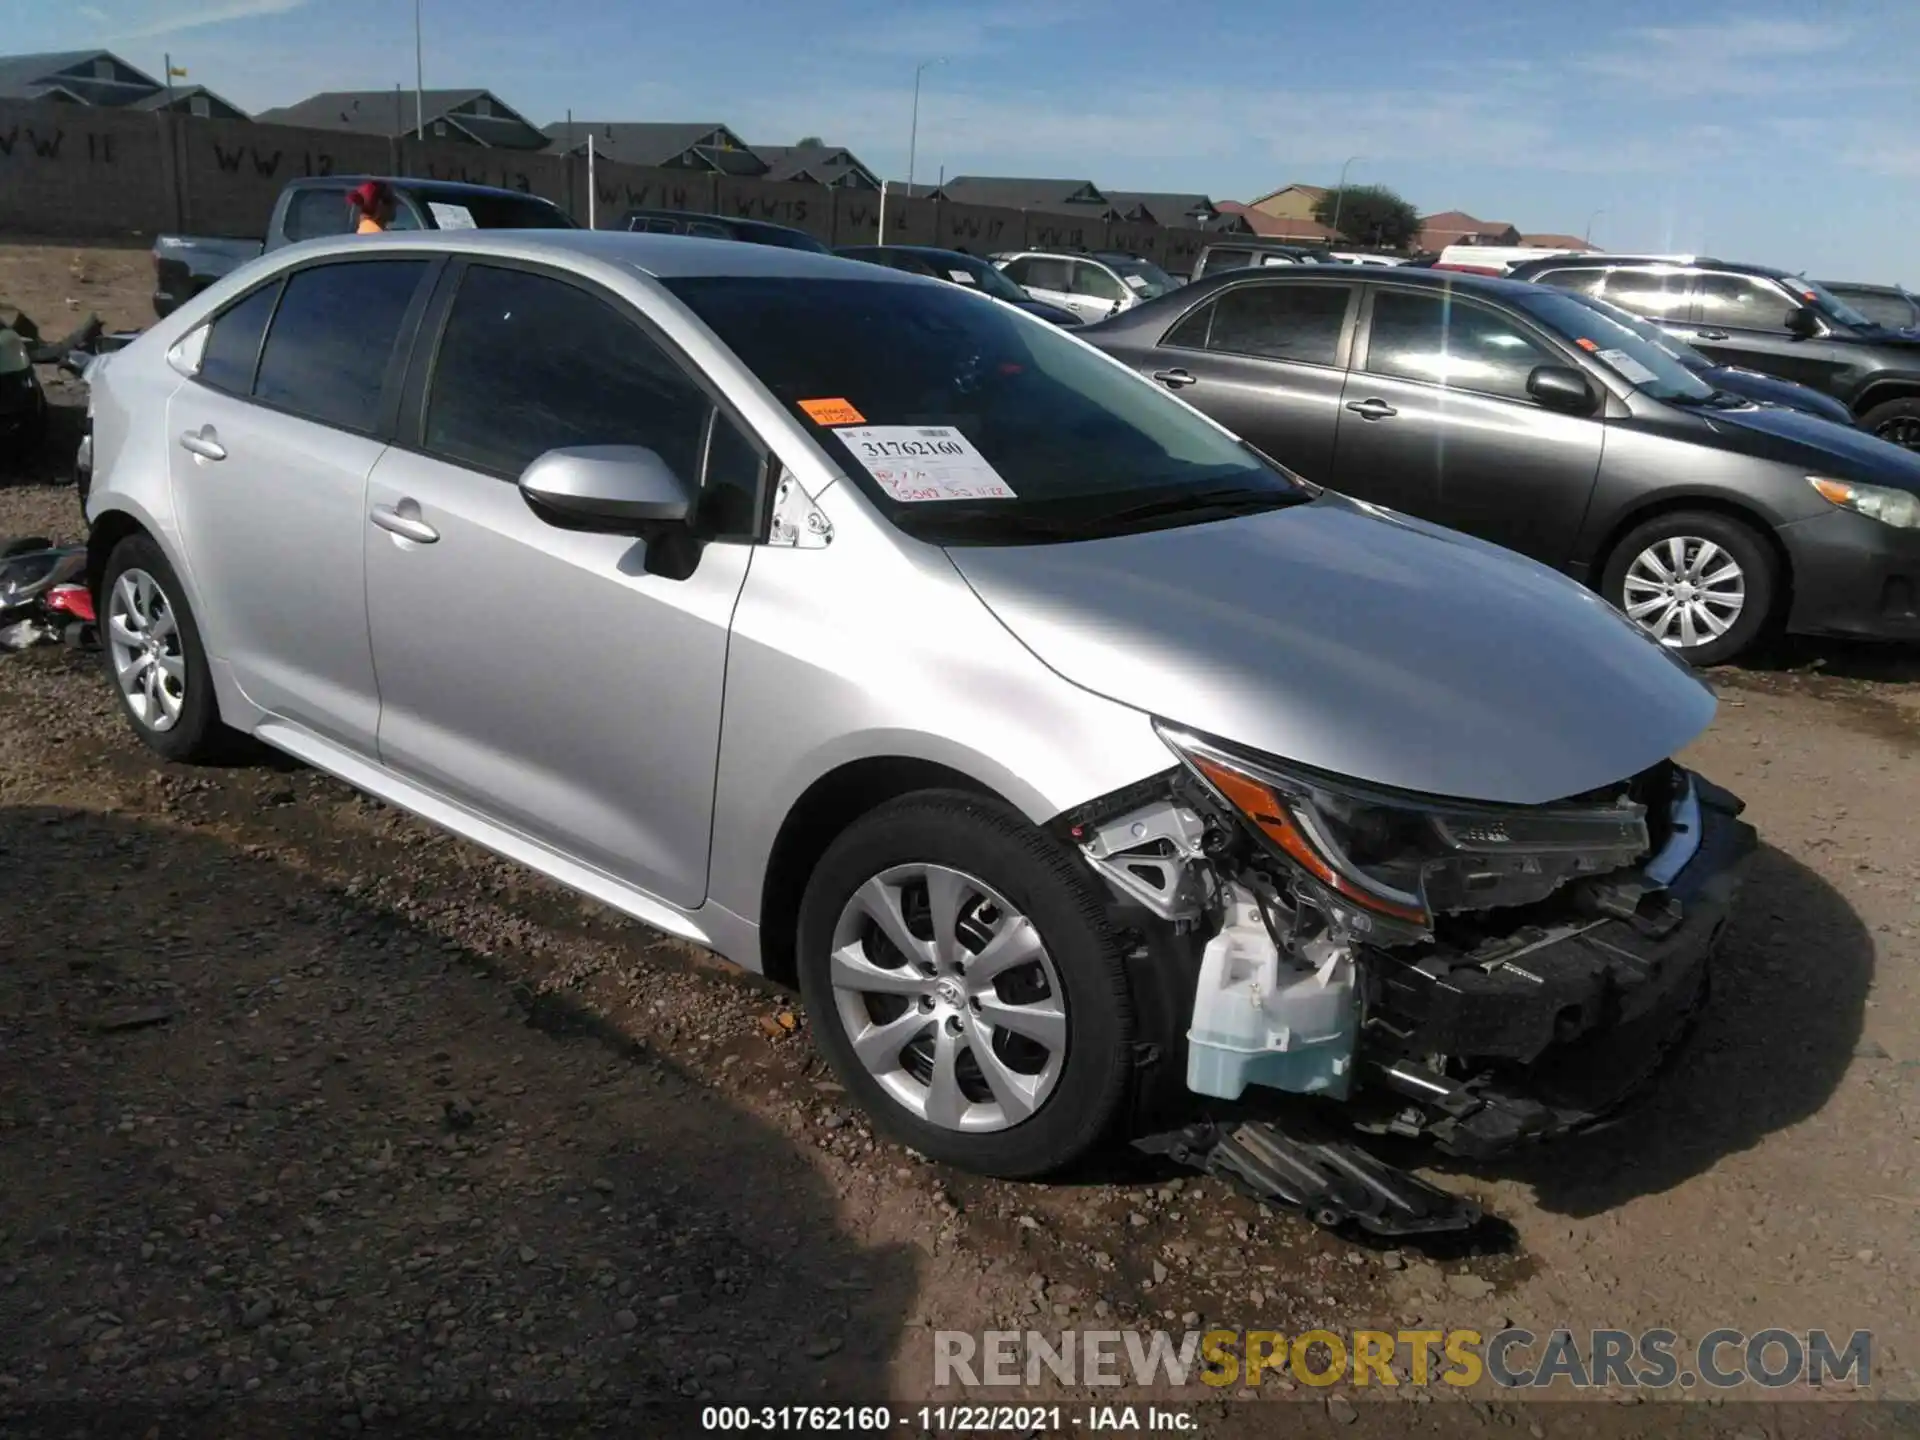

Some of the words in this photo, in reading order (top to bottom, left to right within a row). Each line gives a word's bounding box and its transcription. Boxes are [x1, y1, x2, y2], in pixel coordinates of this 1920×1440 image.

[213, 144, 283, 178] WW
[596, 175, 649, 208] WW
[735, 195, 779, 218] WW
[783, 200, 807, 221] 15
[951, 215, 981, 238] WW
[862, 440, 964, 457] 31762160
